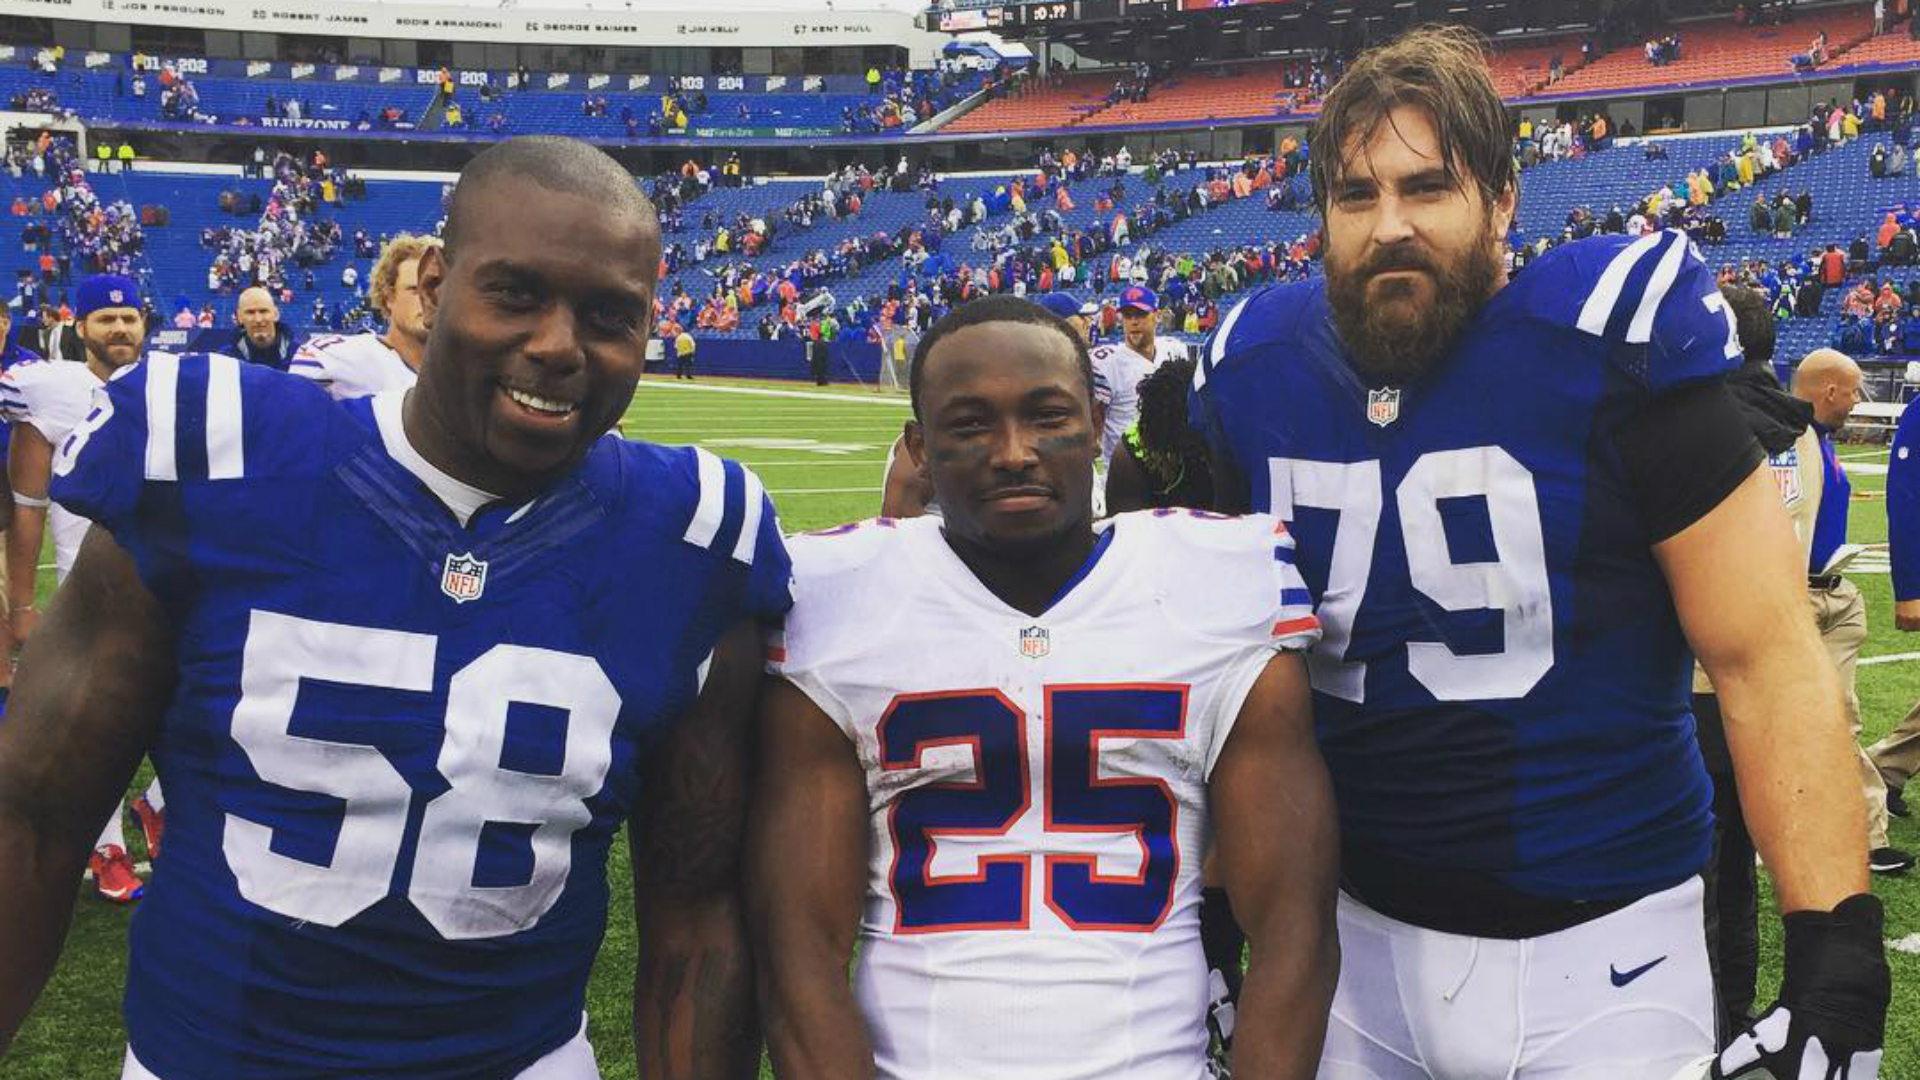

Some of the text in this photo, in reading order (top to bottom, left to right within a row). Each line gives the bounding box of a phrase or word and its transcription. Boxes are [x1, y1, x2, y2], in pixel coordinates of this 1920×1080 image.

[154, 6, 225, 15] FERGUSON
[272, 12, 319, 21] ROBERT
[326, 16, 368, 24] JAMES
[132, 54, 160, 70] 01
[177, 58, 207, 74] 202
[718, 76, 744, 90] 204
[1268, 445, 1555, 704] 79
[449, 573, 478, 595] NFL
[1023, 639, 1048, 655] NFL
[222, 609, 623, 940] 58
[876, 683, 1191, 935] 25
